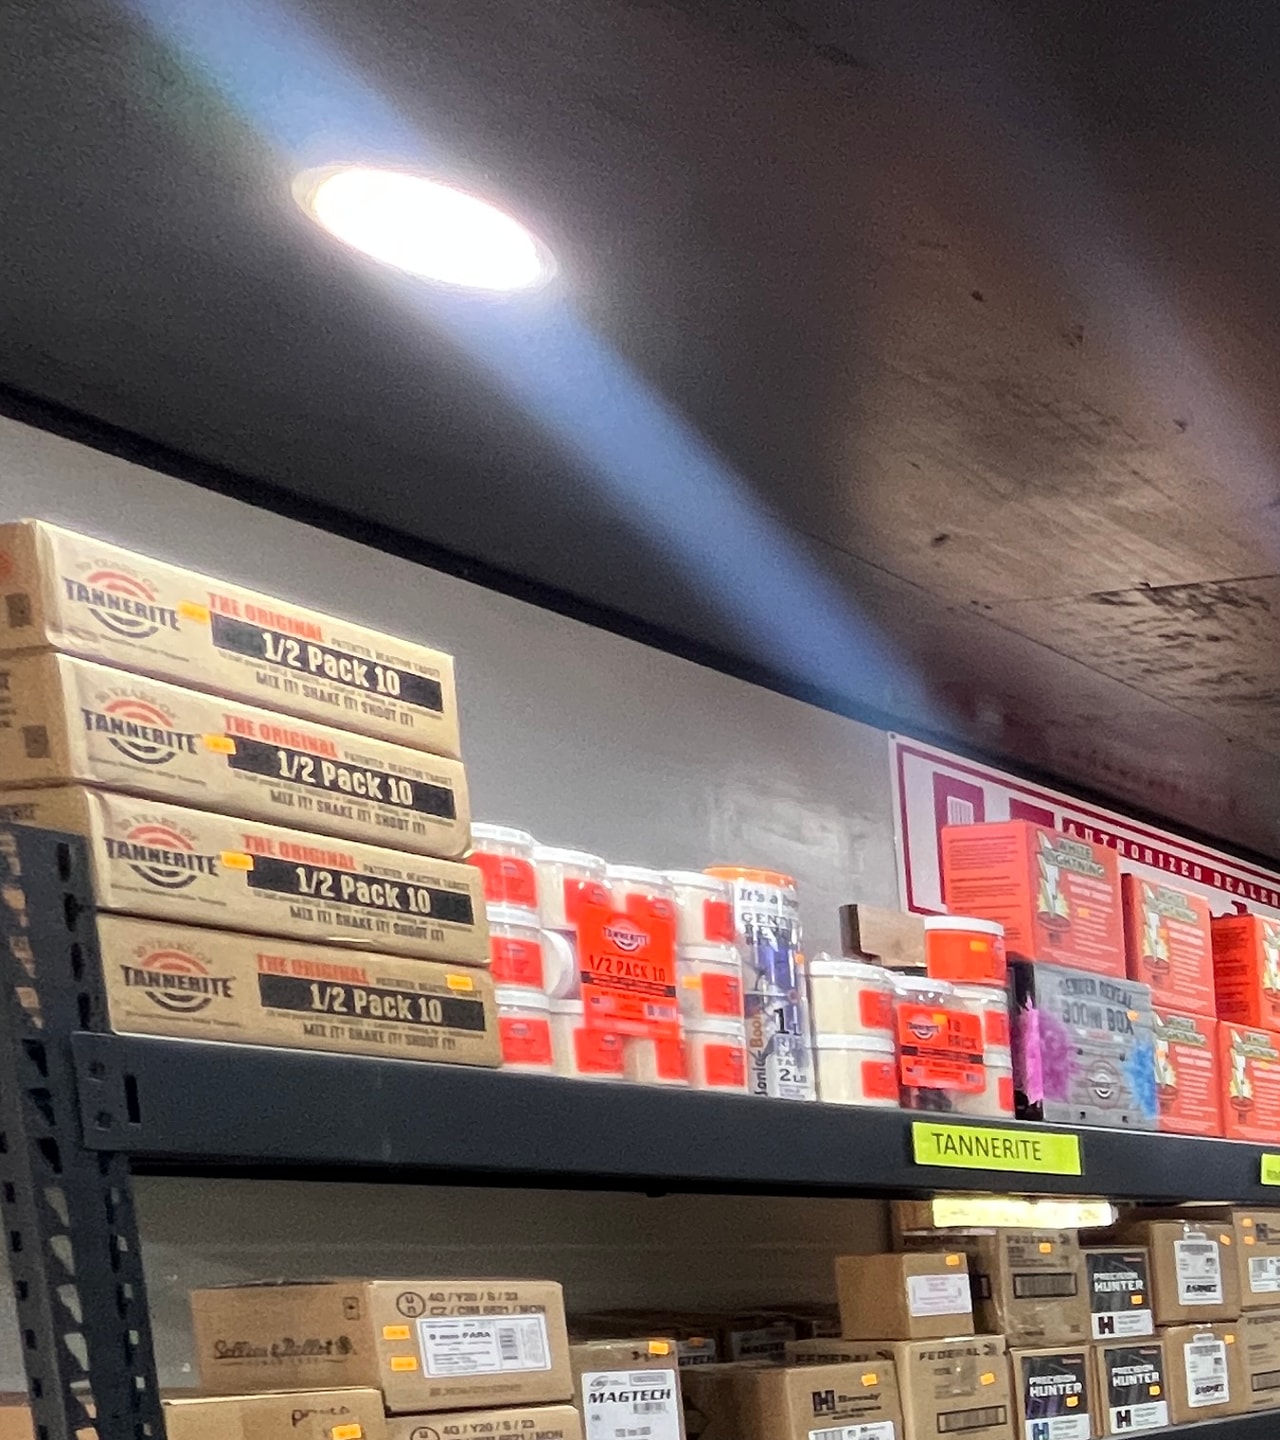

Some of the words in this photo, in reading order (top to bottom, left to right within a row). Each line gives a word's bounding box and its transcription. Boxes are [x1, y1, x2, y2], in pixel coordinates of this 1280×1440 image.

[62, 576, 181, 631] TANNERITE
[207, 592, 239, 615] THE
[245, 603, 324, 642] ORIGINAL
[262, 633, 301, 668] 1/2
[307, 644, 370, 687] Pack
[374, 666, 401, 695] 10
[302, 682, 341, 705] SHAKE
[81, 707, 199, 755] TANNERITE
[222, 714, 255, 735] THE
[259, 722, 339, 759] ORIGINAL
[278, 750, 316, 783] 1/2
[322, 759, 382, 799] Pack
[387, 777, 414, 806] 10
[103, 837, 220, 877] TANNERITE
[241, 834, 279, 856] THE
[283, 842, 357, 871] ORIGINAL
[1068, 824, 1202, 881] AUTHORIZED
[1214, 871, 1280, 907] DEALER
[296, 867, 335, 898] 1/2
[341, 875, 401, 912] Pack
[407, 887, 431, 914] 10
[119, 964, 237, 999] TANNERITE
[257, 954, 290, 976] THE
[292, 957, 369, 985] ORIGINAL
[589, 954, 612, 971] 1/2
[616, 960, 648, 980] PACK
[652, 967, 665, 982] 10
[309, 982, 348, 1013] 1/2
[353, 987, 413, 1019] Pack
[418, 996, 442, 1023] 10
[932, 1132, 1042, 1161] TANNERITE
[1094, 1280, 1144, 1292] HUNTER
[1099, 1316, 1115, 1334] H
[919, 1348, 980, 1360] FEDERAL
[588, 1387, 673, 1404] MAGTECH
[1030, 1383, 1082, 1397] HUNTER
[1112, 1373, 1160, 1387] HUNTER
[812, 1390, 835, 1412] H
